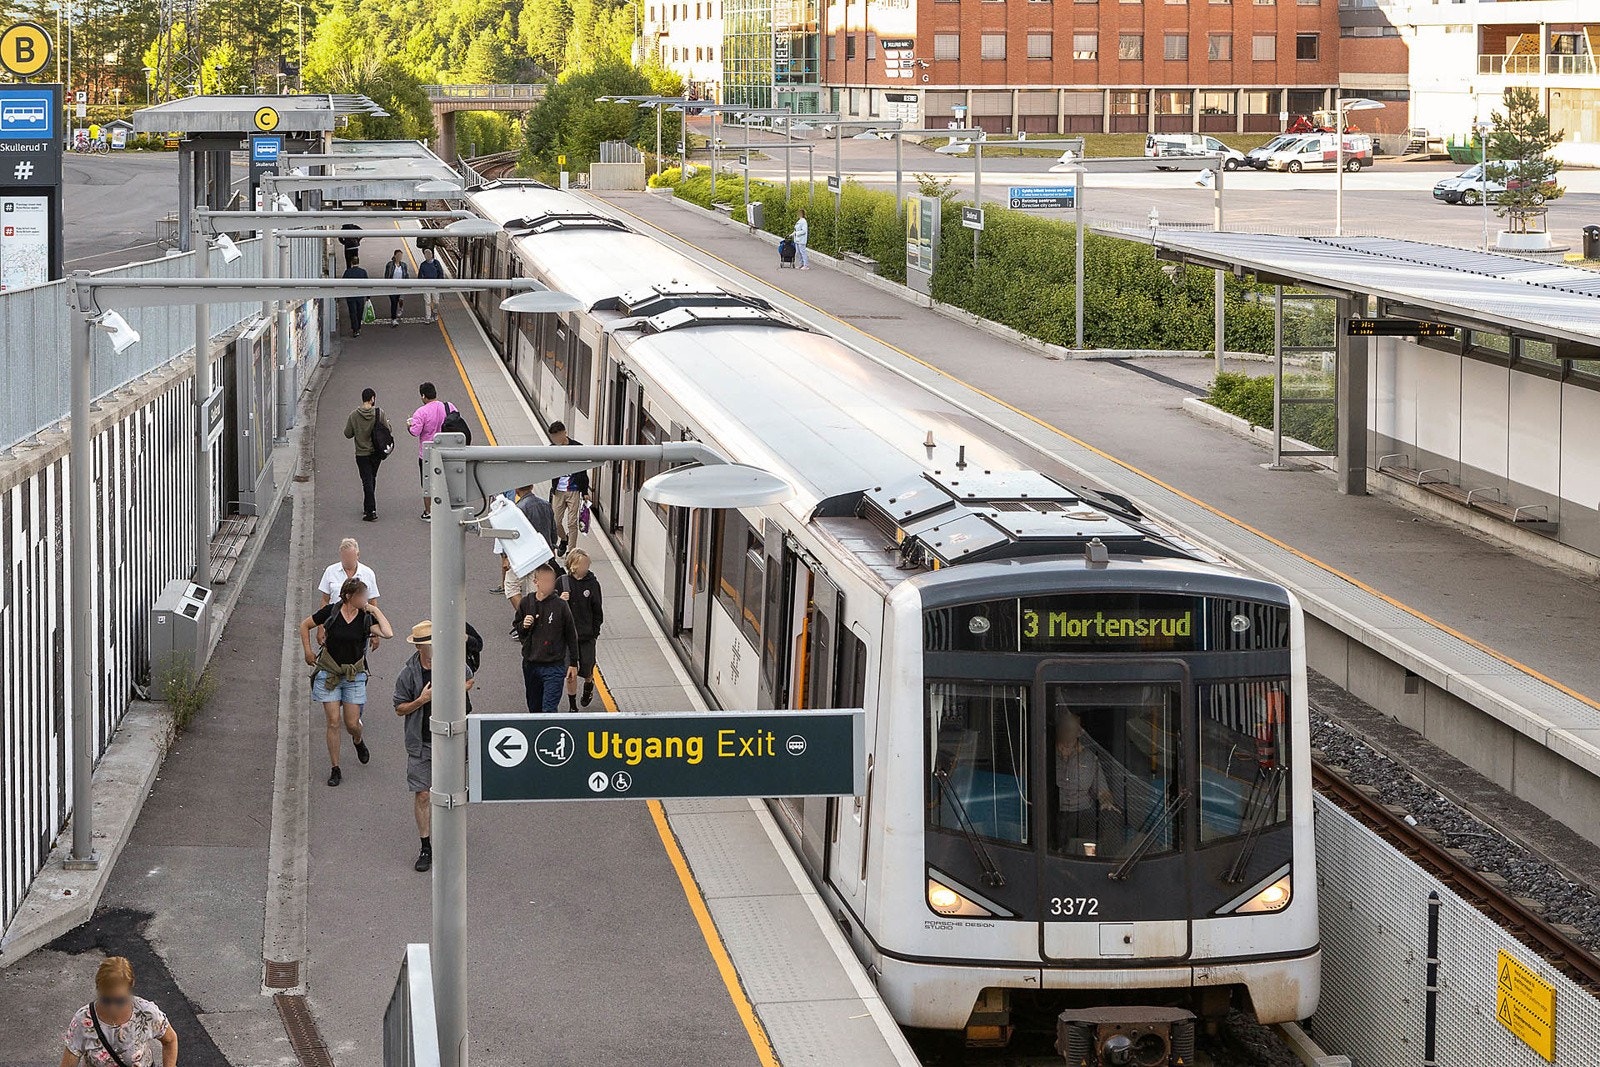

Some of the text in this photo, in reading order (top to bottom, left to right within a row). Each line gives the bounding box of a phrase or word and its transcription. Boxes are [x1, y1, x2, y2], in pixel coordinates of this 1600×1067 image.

[15, 36, 35, 63] B
[922, 74, 930, 82] G
[260, 112, 270, 126] C
[0, 143, 48, 151] Skullerud T
[1024, 611, 1191, 638] 3 Mortensrud
[587, 729, 776, 765] Utgang Exit
[1050, 897, 1099, 916] 3372
